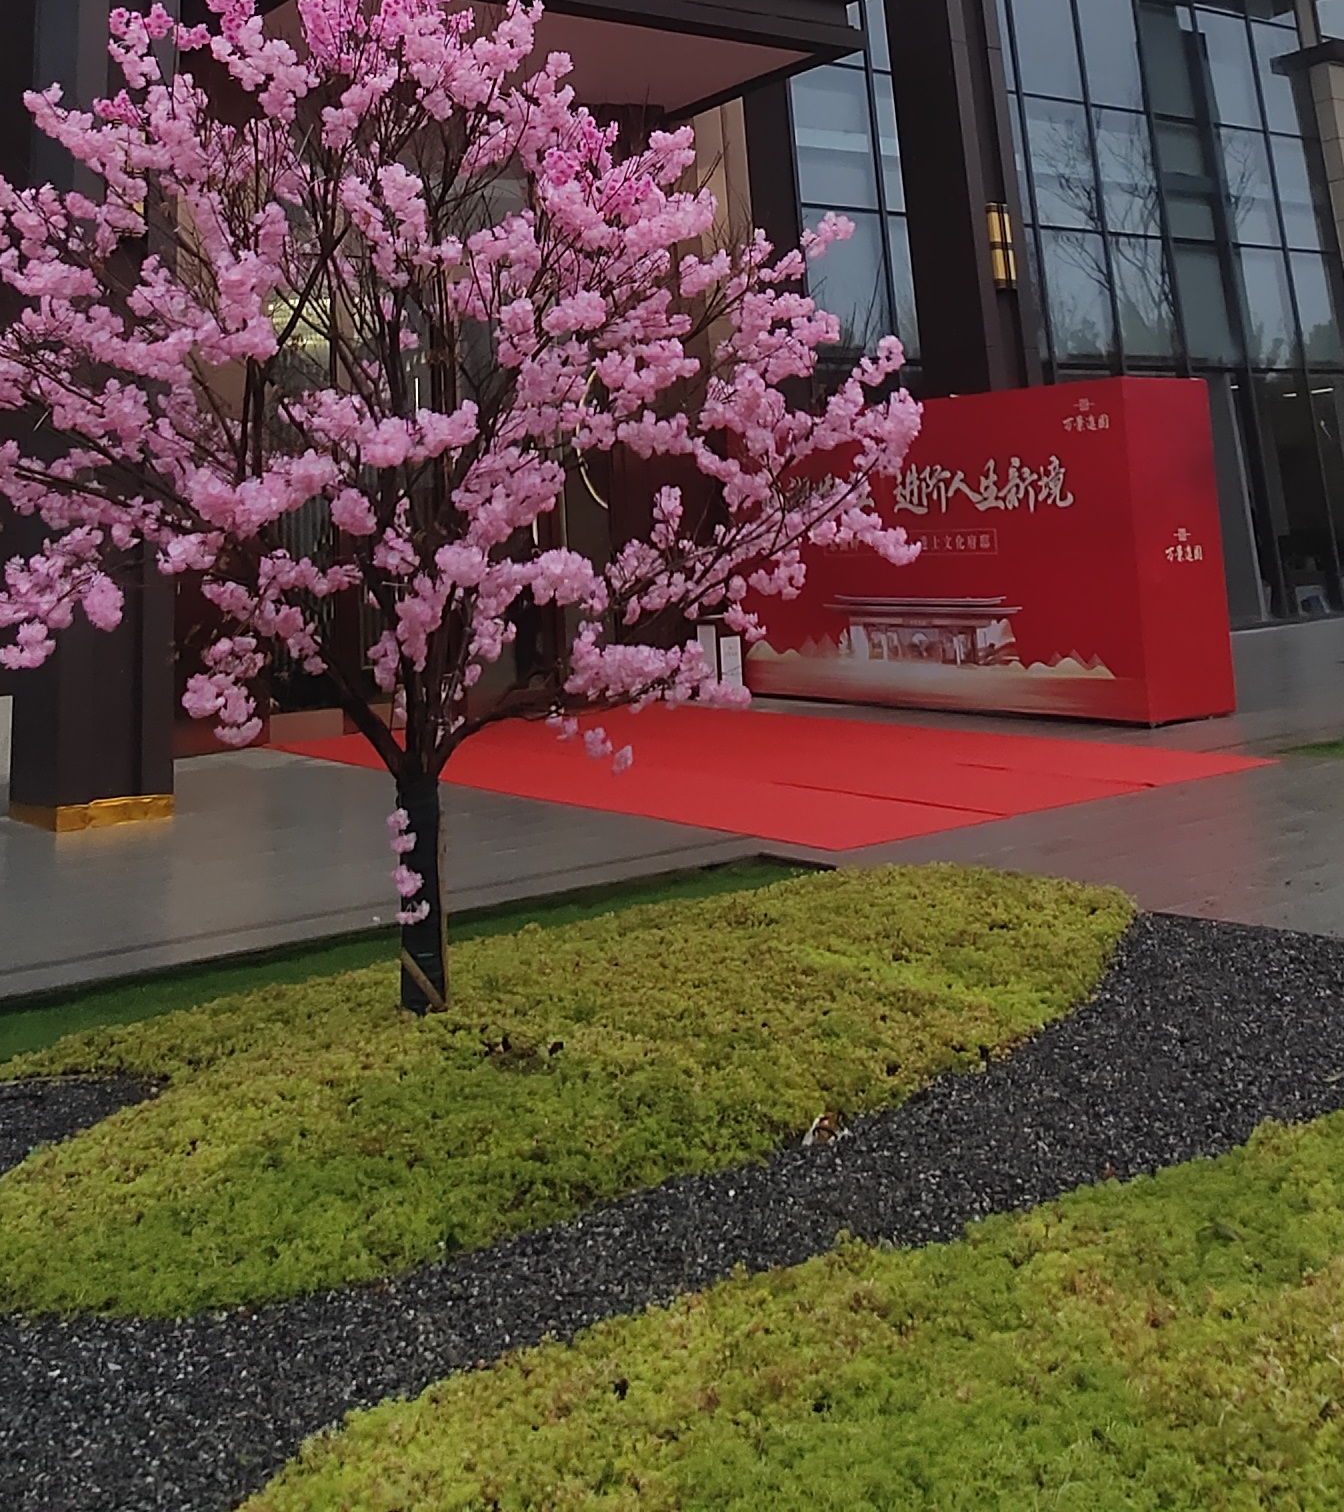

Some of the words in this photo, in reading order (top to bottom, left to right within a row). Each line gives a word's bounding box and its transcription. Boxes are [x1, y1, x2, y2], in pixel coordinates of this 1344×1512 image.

[894, 455, 1074, 515] 进阶人生新境
